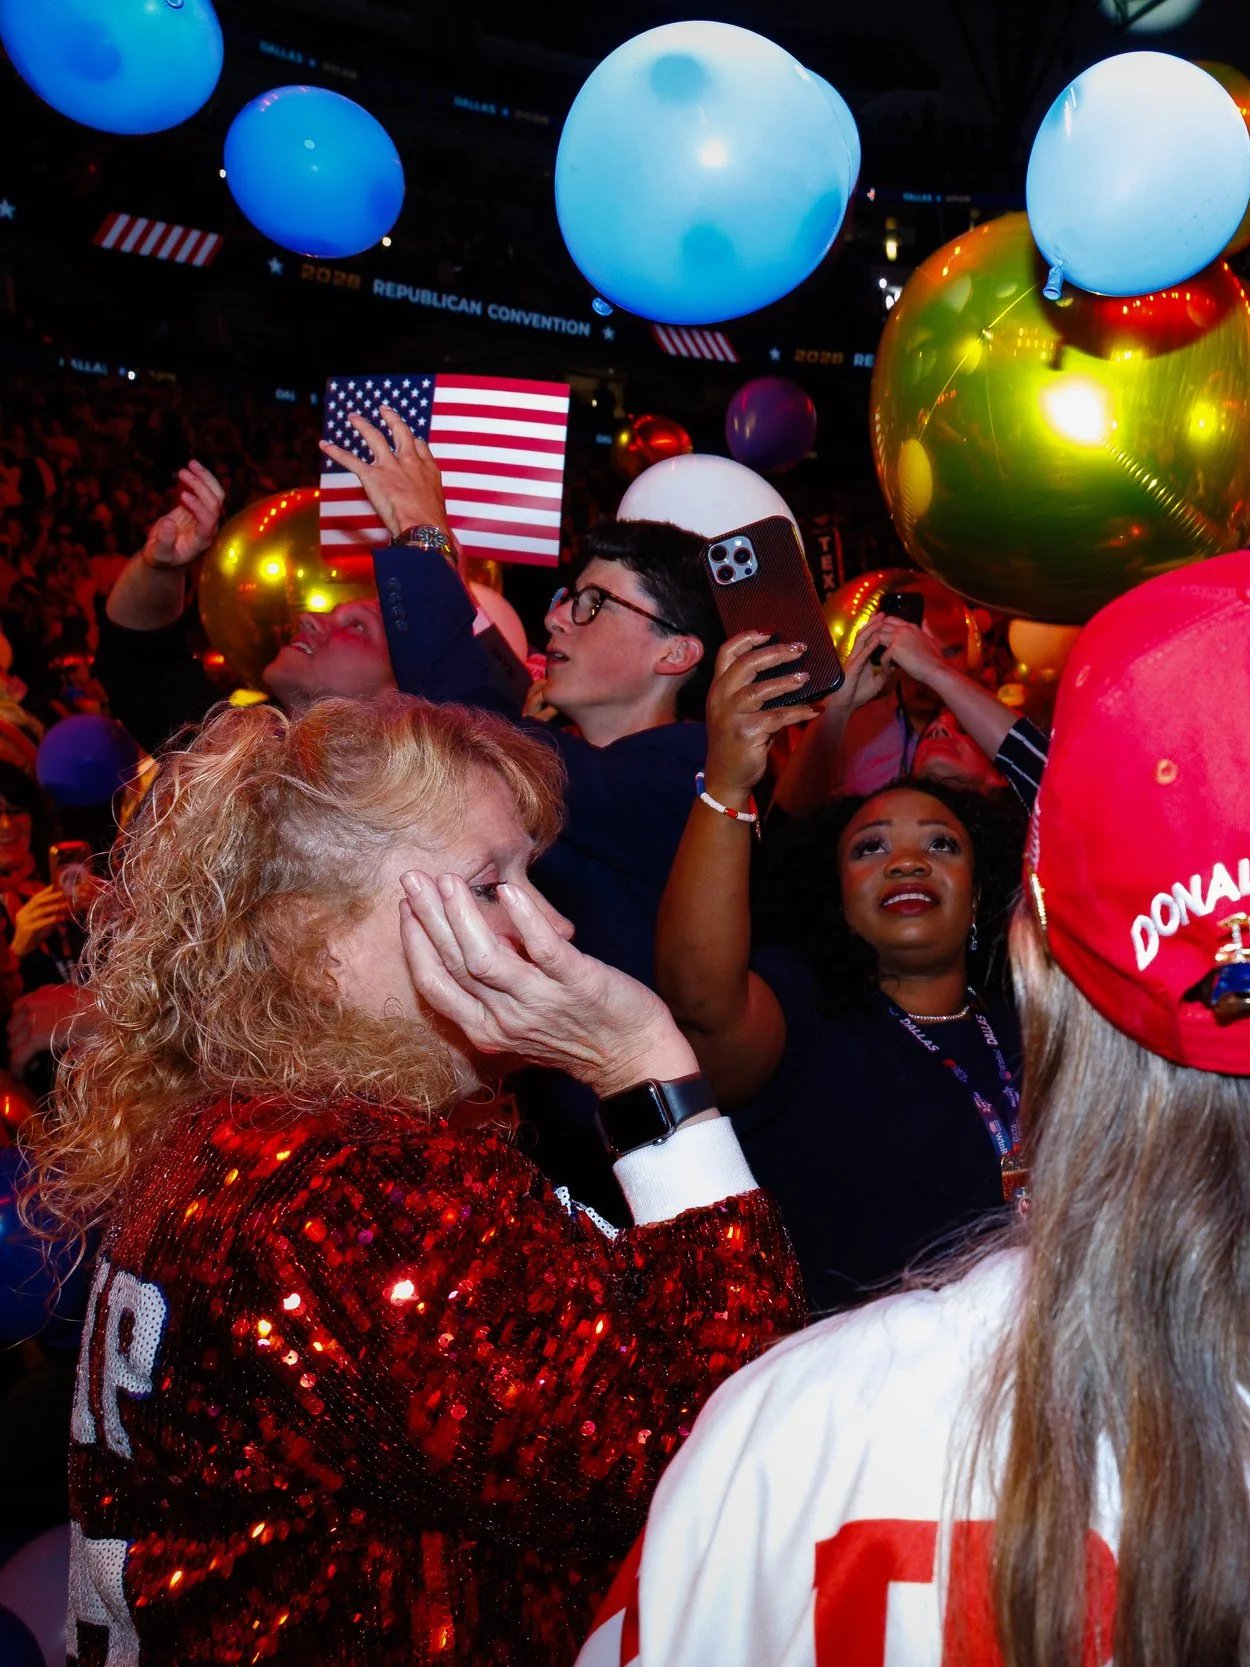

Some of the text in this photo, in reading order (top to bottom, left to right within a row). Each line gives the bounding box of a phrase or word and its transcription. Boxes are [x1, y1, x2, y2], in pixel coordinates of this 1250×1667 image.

[372, 278, 483, 318] REPUBLICAN
[487, 302, 591, 338] CONVENTION
[899, 1017, 940, 1053] DALLAS
[995, 1132, 1008, 1155] WinR
